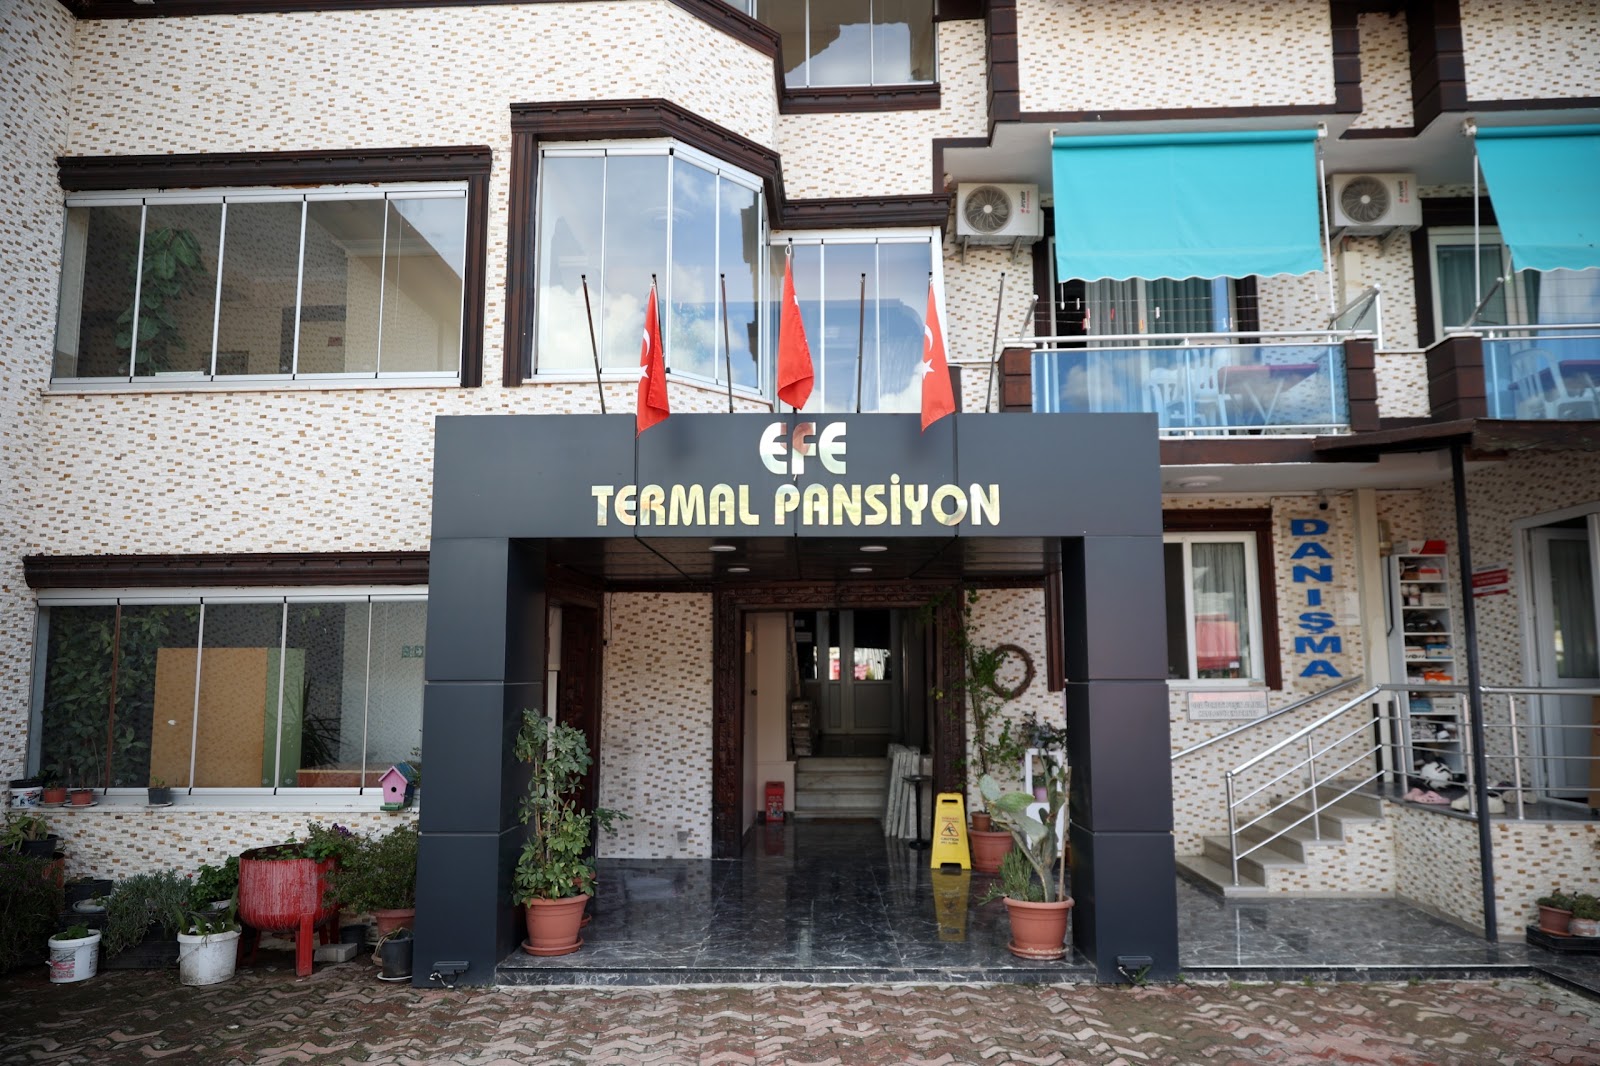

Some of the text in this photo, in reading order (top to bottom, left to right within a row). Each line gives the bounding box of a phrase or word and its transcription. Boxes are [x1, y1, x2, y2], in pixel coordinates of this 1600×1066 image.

[758, 421, 847, 475] EFE
[591, 473, 1001, 527] TERMAL PANSİYON
[1290, 518, 1343, 678] DANIŞMA
